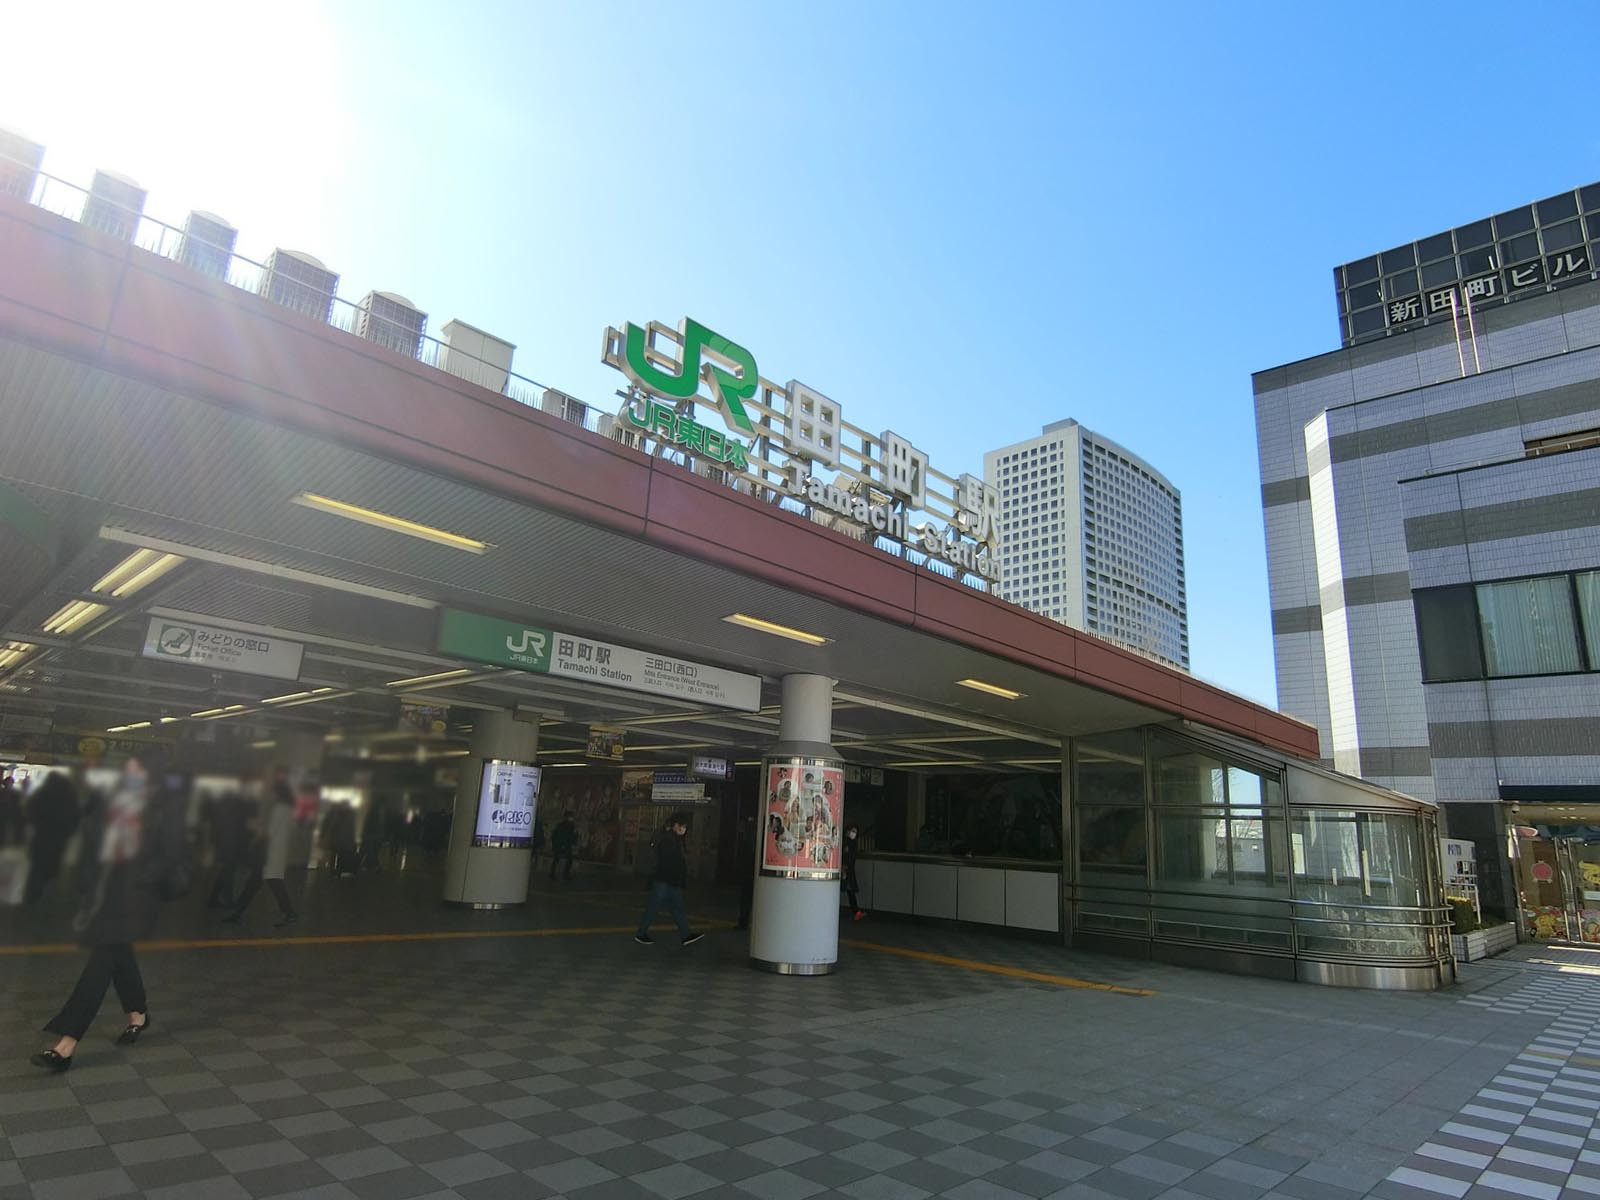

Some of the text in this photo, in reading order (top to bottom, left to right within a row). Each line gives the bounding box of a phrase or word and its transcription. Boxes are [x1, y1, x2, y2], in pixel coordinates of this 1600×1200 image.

[1390, 254, 1585, 322] 新田町ビル
[617, 316, 759, 439] JR
[627, 399, 749, 469] JR東日本
[785, 379, 1001, 548] 田町駅
[785, 459, 1001, 583] Tamachi Station
[198, 631, 269, 652] みどりの窓口
[506, 631, 546, 657] JR
[559, 639, 611, 665] 田町駅
[510, 654, 538, 665] JR東日本
[557, 658, 633, 683] Tamachi Station
[504, 810, 532, 825] RISO
